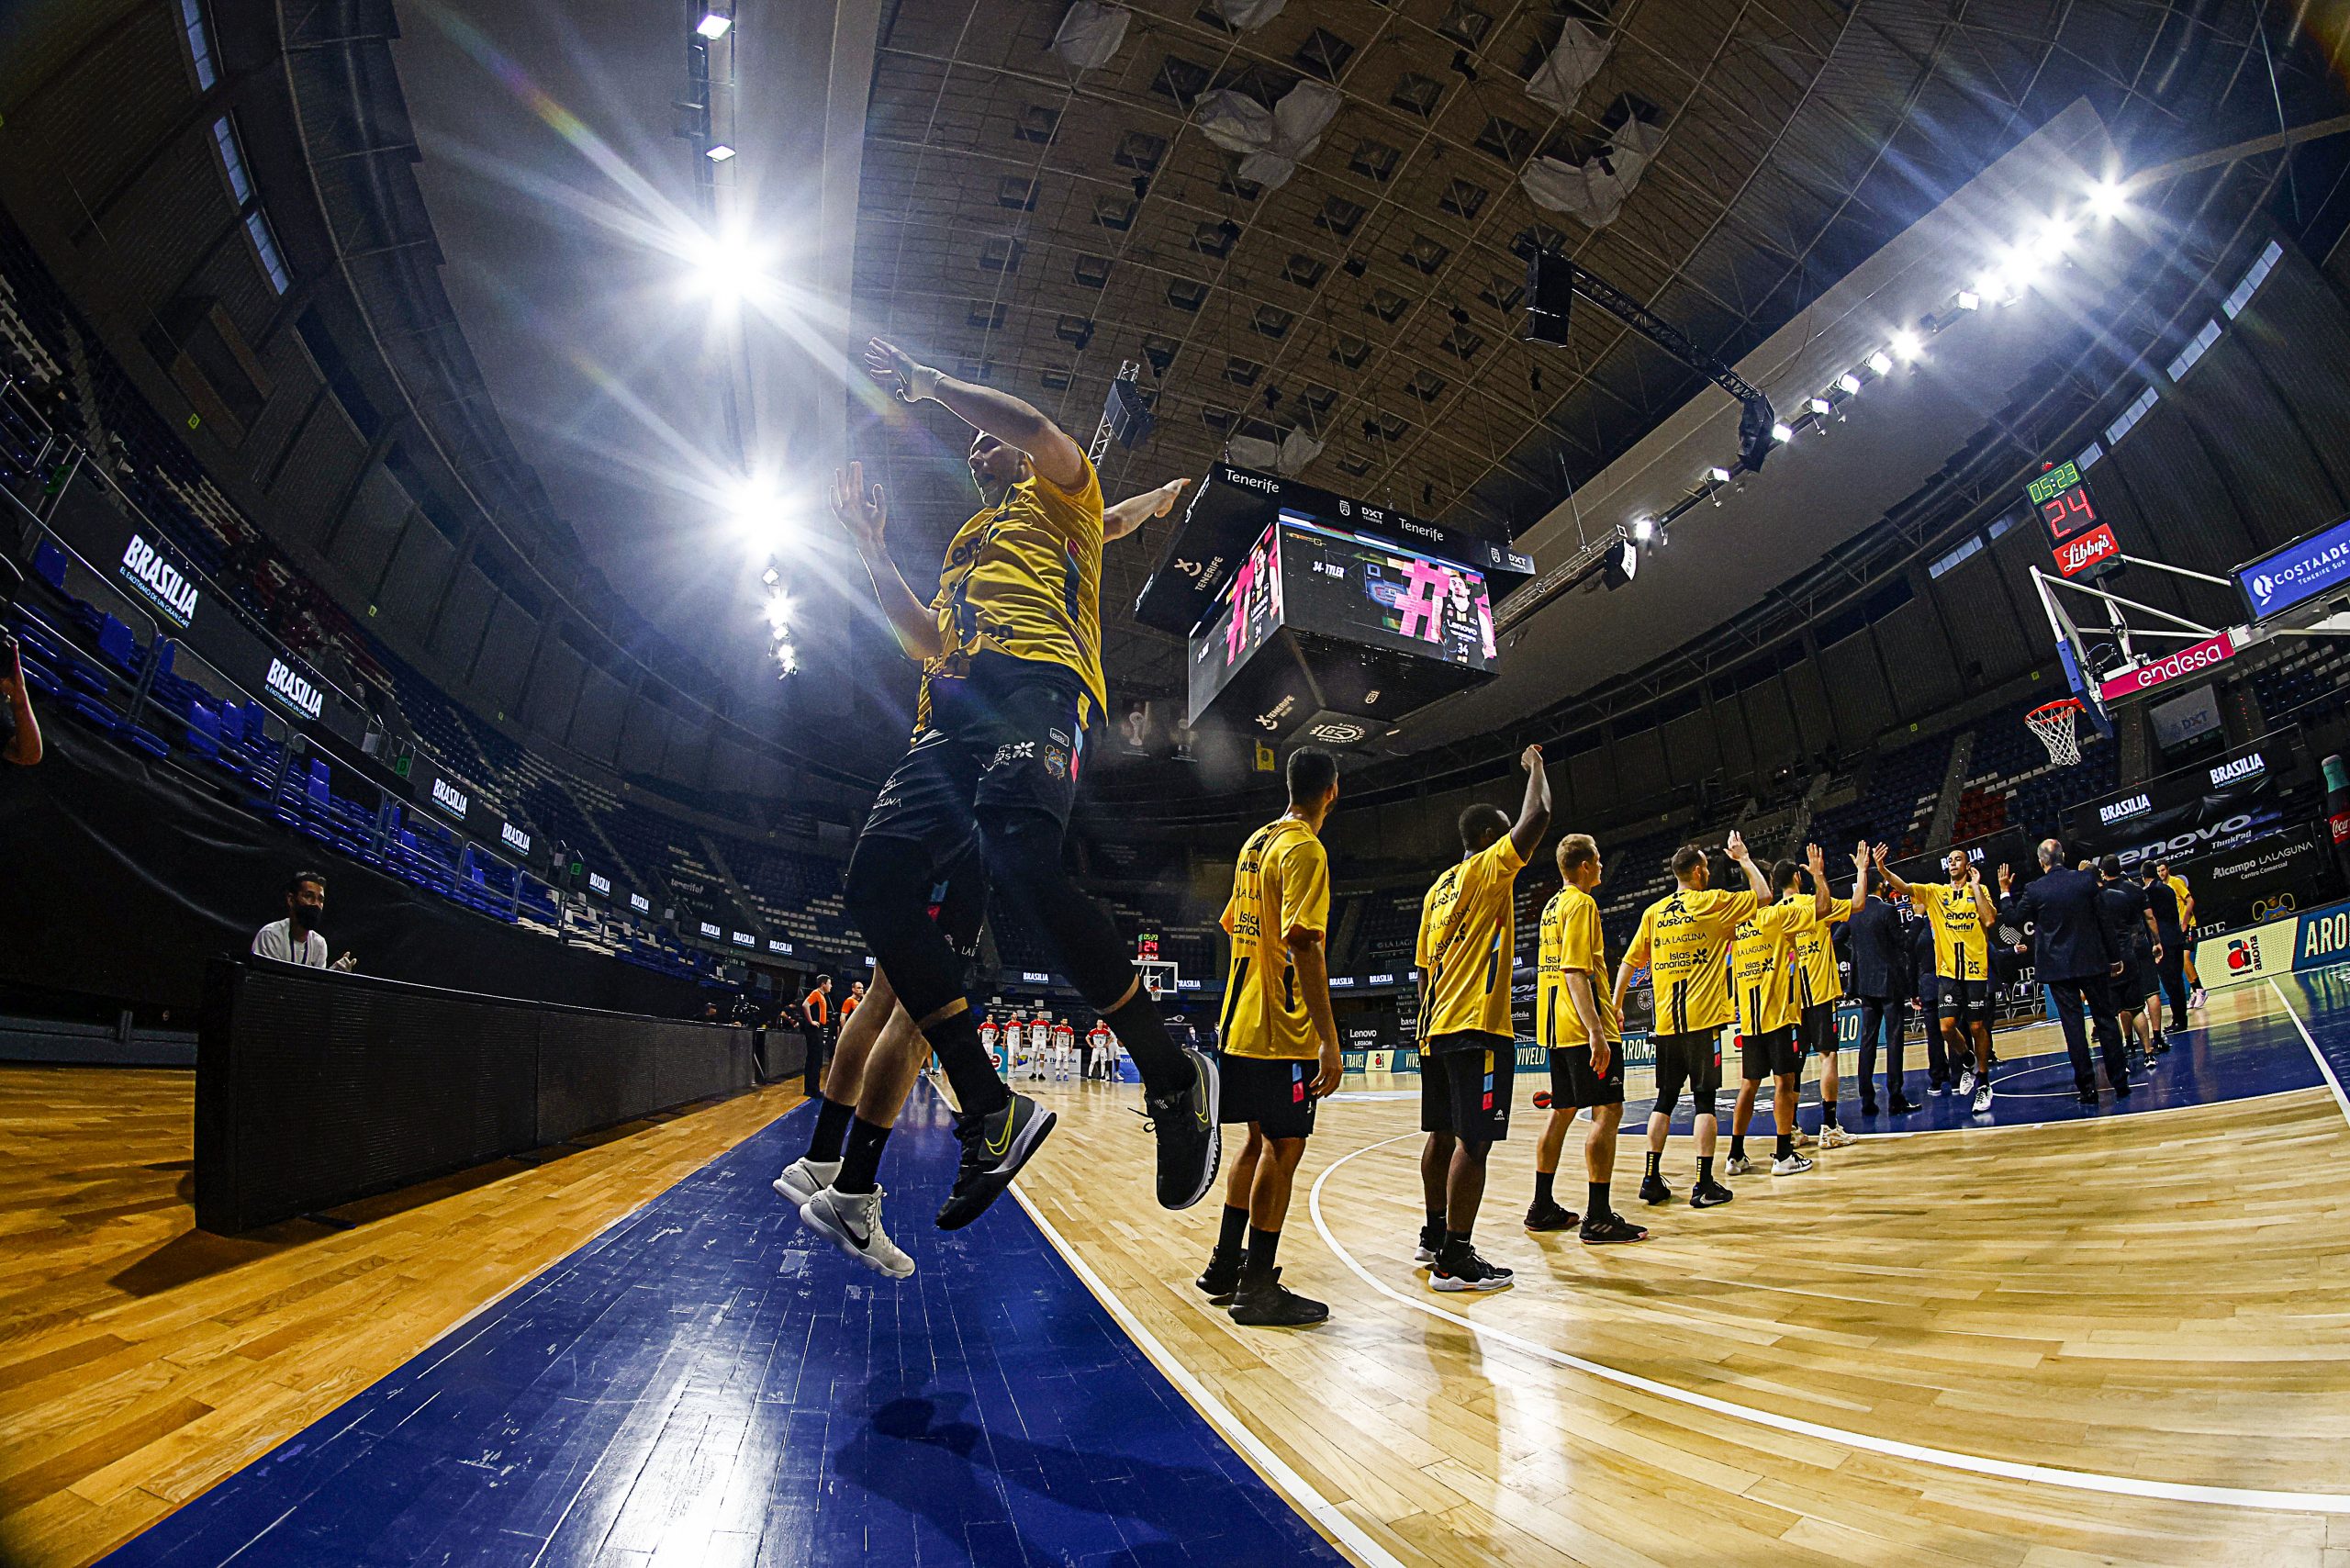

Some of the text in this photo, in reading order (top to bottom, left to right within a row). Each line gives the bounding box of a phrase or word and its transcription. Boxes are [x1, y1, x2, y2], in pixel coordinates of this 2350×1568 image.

[1225, 468, 1280, 494] Tenerife
[2029, 463, 2079, 503] 05:23
[1361, 507, 1383, 520] DXT
[2044, 488, 2094, 538] 24
[1398, 517, 1444, 542] Tenerife
[1508, 554, 1527, 566] DXT
[2062, 534, 2110, 571] Libby's
[2274, 540, 2350, 585] COSTAADE
[122, 533, 198, 620] BRASILIA
[1194, 555, 1224, 591] TENERIFE
[1447, 619, 1477, 635] Lenovo
[1457, 643, 1469, 655] 34
[2137, 644, 2222, 687] endesa
[267, 657, 323, 718] BRASILIA
[1266, 694, 1295, 720] TENERIFE
[2182, 710, 2210, 731] DXT
[2210, 753, 2265, 785] BRASILIA
[432, 778, 467, 815] BRASILIA
[2099, 793, 2151, 823] BRASILIA
[501, 822, 531, 852] BRASILIA
[2210, 830, 2252, 849] ThinkPad
[1940, 847, 1985, 871] BRLIA
[2213, 860, 2256, 879] Alcampo
[2241, 861, 2288, 879] Centro Comercial
[589, 872, 610, 893] BRASILIA
[631, 893, 649, 911] BRASILIA
[700, 921, 720, 937] BRASILIA
[1657, 914, 1696, 928] austral
[733, 931, 755, 946] BRASILIA
[1673, 932, 1707, 944] LAGUNA
[2304, 913, 2350, 958] ARO
[769, 939, 792, 953] BRASILIA
[1144, 941, 1158, 952] 24
[1746, 944, 1773, 955] LAGUNA
[1669, 951, 1691, 960] Islas
[1654, 959, 1691, 971] Canarias
[1736, 968, 1762, 979] anarias
[1745, 961, 1761, 969] Islas
[1968, 961, 1979, 974] 25
[1023, 971, 1048, 982] BRASILIA
[1329, 977, 1354, 986] BRASILIA
[1370, 974, 1393, 984] BRASILIA
[1349, 1029, 1377, 1038] Lenovo
[1346, 1054, 1364, 1068] TRAVEL
[1405, 1050, 1420, 1068] VÍVE
[1516, 1044, 1547, 1066] VÍVELO
